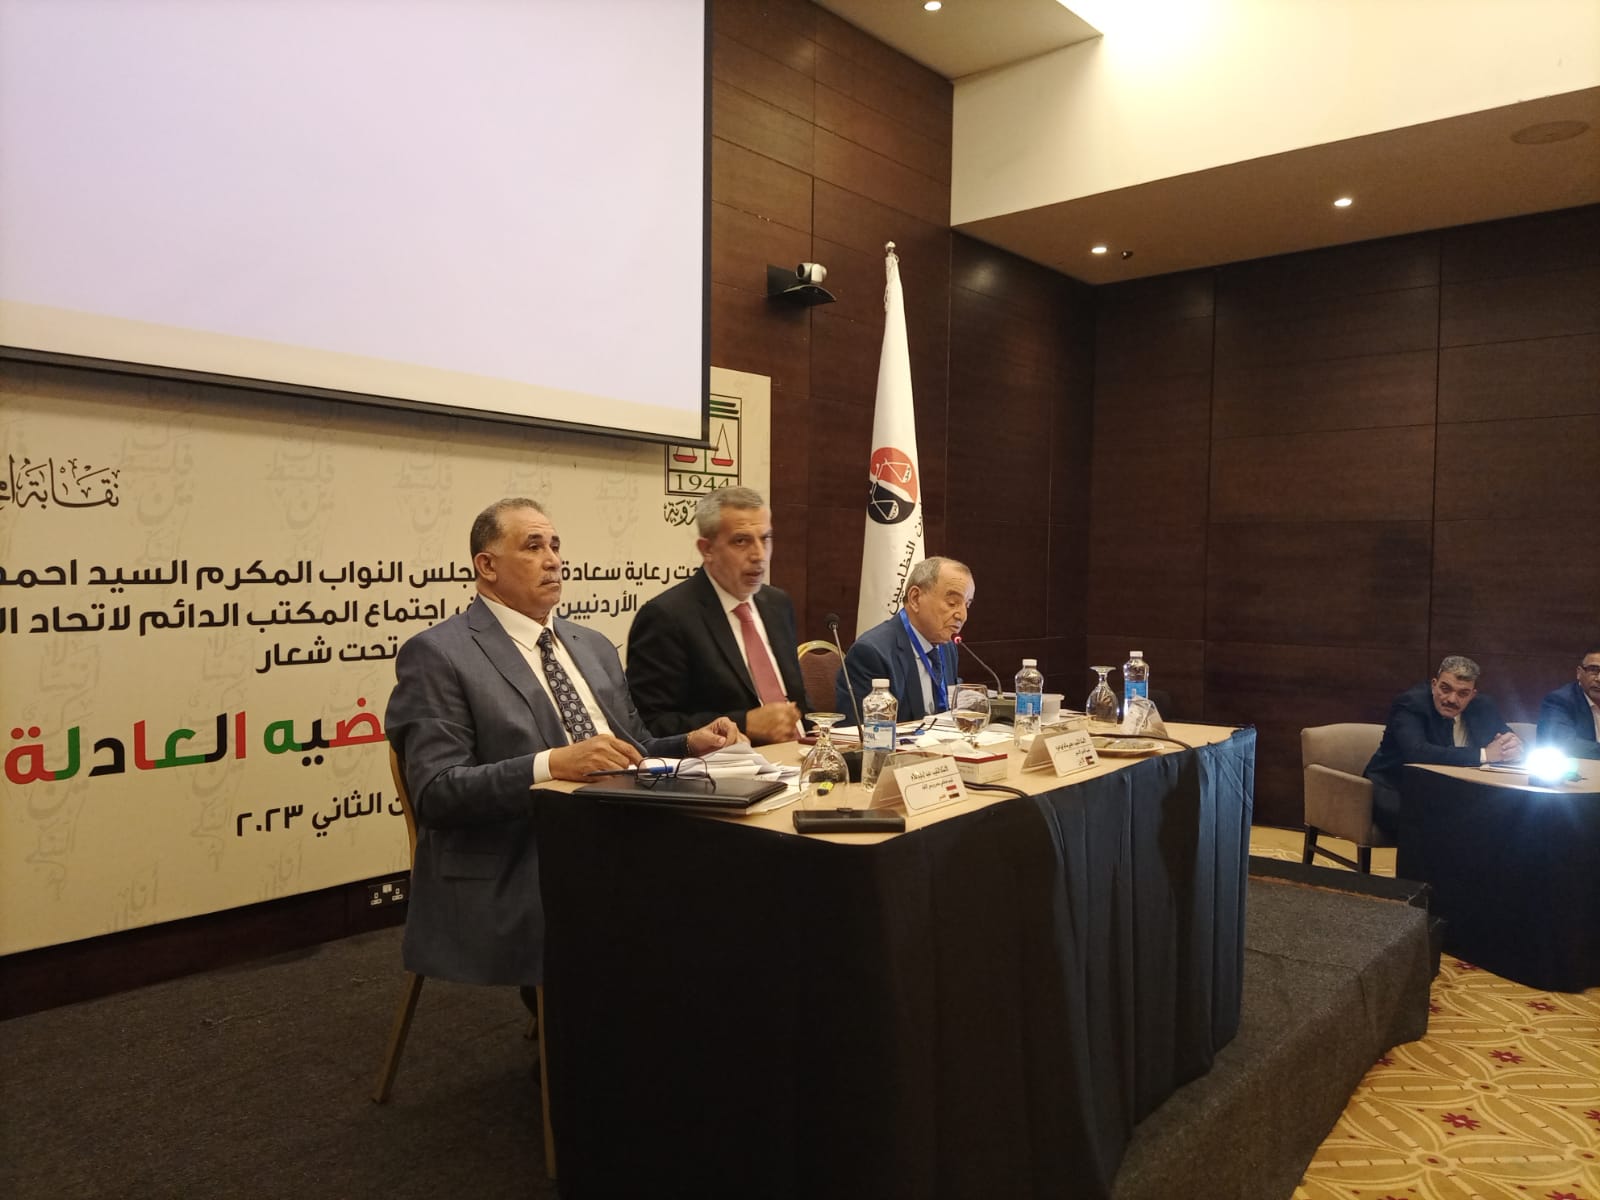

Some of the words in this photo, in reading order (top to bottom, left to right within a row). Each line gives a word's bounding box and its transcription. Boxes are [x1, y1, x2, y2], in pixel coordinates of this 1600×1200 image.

[674, 473, 729, 491] 1944
[88, 559, 188, 594] السيد
[196, 559, 312, 591] المكرم
[319, 560, 402, 591] النواب
[409, 561, 476, 589] جلس
[561, 561, 621, 581] سعادة
[625, 561, 670, 586] رعاية
[29, 603, 131, 633] لاتحاد
[139, 598, 239, 636] الدائم
[246, 600, 358, 633] المكتب
[365, 598, 445, 627] اجتماع
[556, 591, 637, 620] الأردنيين
[255, 635, 332, 674] شعار
[338, 635, 398, 661] تحت
[4, 710, 247, 785] العادلة
[263, 697, 388, 767] ضيه
[311, 789, 382, 838] الثاني
